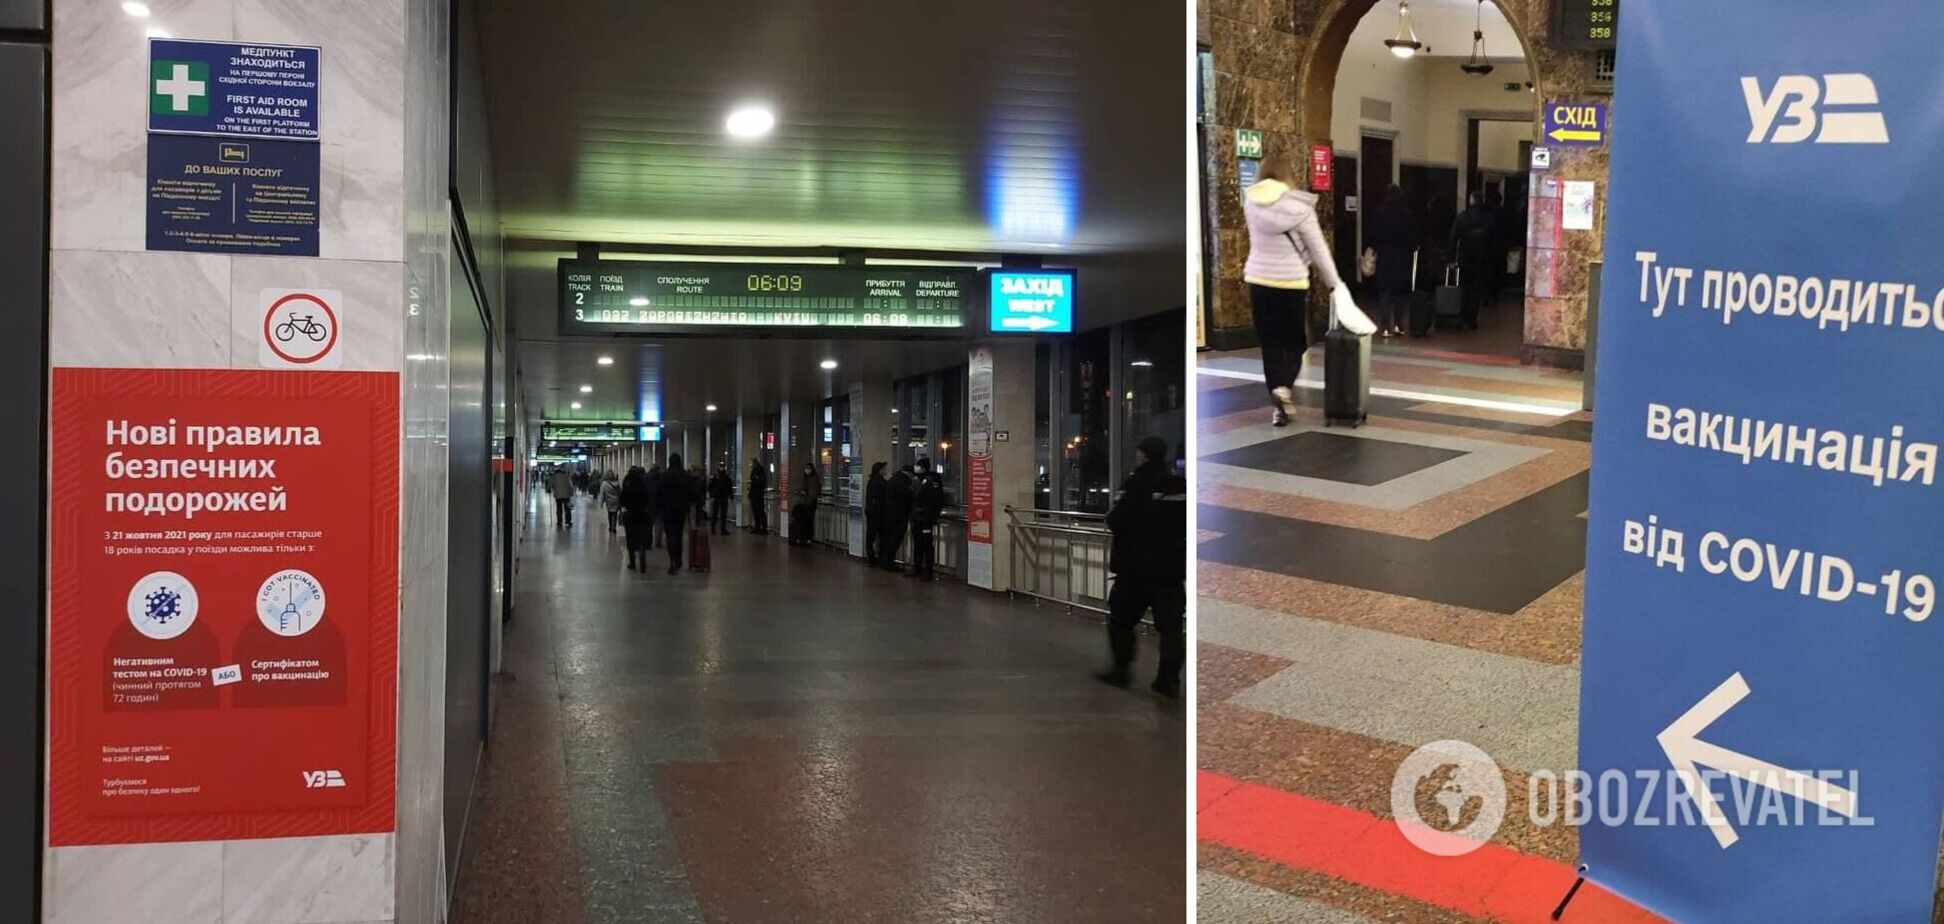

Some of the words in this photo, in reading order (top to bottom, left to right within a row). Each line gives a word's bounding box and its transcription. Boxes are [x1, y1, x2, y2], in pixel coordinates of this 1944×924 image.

[1590, 28, 1611, 38] 358
[241, 48, 295, 58] МЕДПУНКТ
[230, 57, 305, 69] ЗНАХОДИТЬСЯ
[242, 70, 278, 78] ПЕРШОМУ
[219, 76, 247, 84] СХІДНОЇ
[248, 78, 282, 86] СТОРОНИ
[227, 95, 256, 104] FIRST
[257, 96, 274, 105] AID
[278, 98, 307, 107] ROOM
[234, 106, 243, 114] IS
[245, 107, 300, 118] AVAILABLE
[1554, 106, 1597, 128] СХІД
[184, 165, 200, 174] ДО
[203, 165, 240, 176] ВАШИХ
[243, 167, 284, 177] ПОСЛУГ
[600, 274, 623, 283] ПОЇЗД
[657, 276, 710, 284] СПОЛУЧЕННЯ
[748, 275, 802, 291] 06:09
[866, 280, 905, 288] ПРИБУТТЯ
[1634, 250, 1693, 318] Тут
[676, 286, 703, 294] ROUTE
[1001, 277, 1064, 297] ЗАХІД
[576, 292, 584, 304] 2
[1008, 299, 1056, 312] WEST
[576, 309, 584, 320] 3
[106, 418, 176, 446] Нові
[186, 425, 321, 452] правила
[1646, 403, 1939, 487] вакцинація
[106, 452, 276, 479] безпечних
[106, 486, 287, 519] подорожей
[113, 531, 123, 540] 21
[164, 531, 187, 539] 2021
[189, 532, 212, 541] року
[214, 532, 231, 540] для
[235, 530, 284, 541] пасажирів
[104, 546, 114, 554] 18
[117, 545, 142, 556] років
[145, 546, 185, 554] посадка
[187, 546, 194, 555] у
[195, 545, 228, 554] поїзди
[229, 545, 273, 553] можлива
[275, 544, 305, 552] тільки
[1623, 514, 1685, 573] від
[1699, 530, 1935, 623] COVID-19
[276, 574, 320, 600] VACCINATED
[113, 657, 174, 666] Негативним
[252, 659, 319, 670] Сертифікатом
[113, 670, 148, 678] тестом
[150, 670, 161, 678] на
[164, 668, 207, 677] COVID-19
[218, 670, 236, 680] АБО
[252, 672, 269, 682] про
[271, 670, 329, 681] вакцинацію
[113, 681, 153, 691] (чинний
[155, 681, 201, 692] протягом
[113, 694, 124, 702] 72
[126, 694, 159, 703] годин)
[135, 755, 170, 763] uz.gov.ua
[102, 789, 117, 797] про
